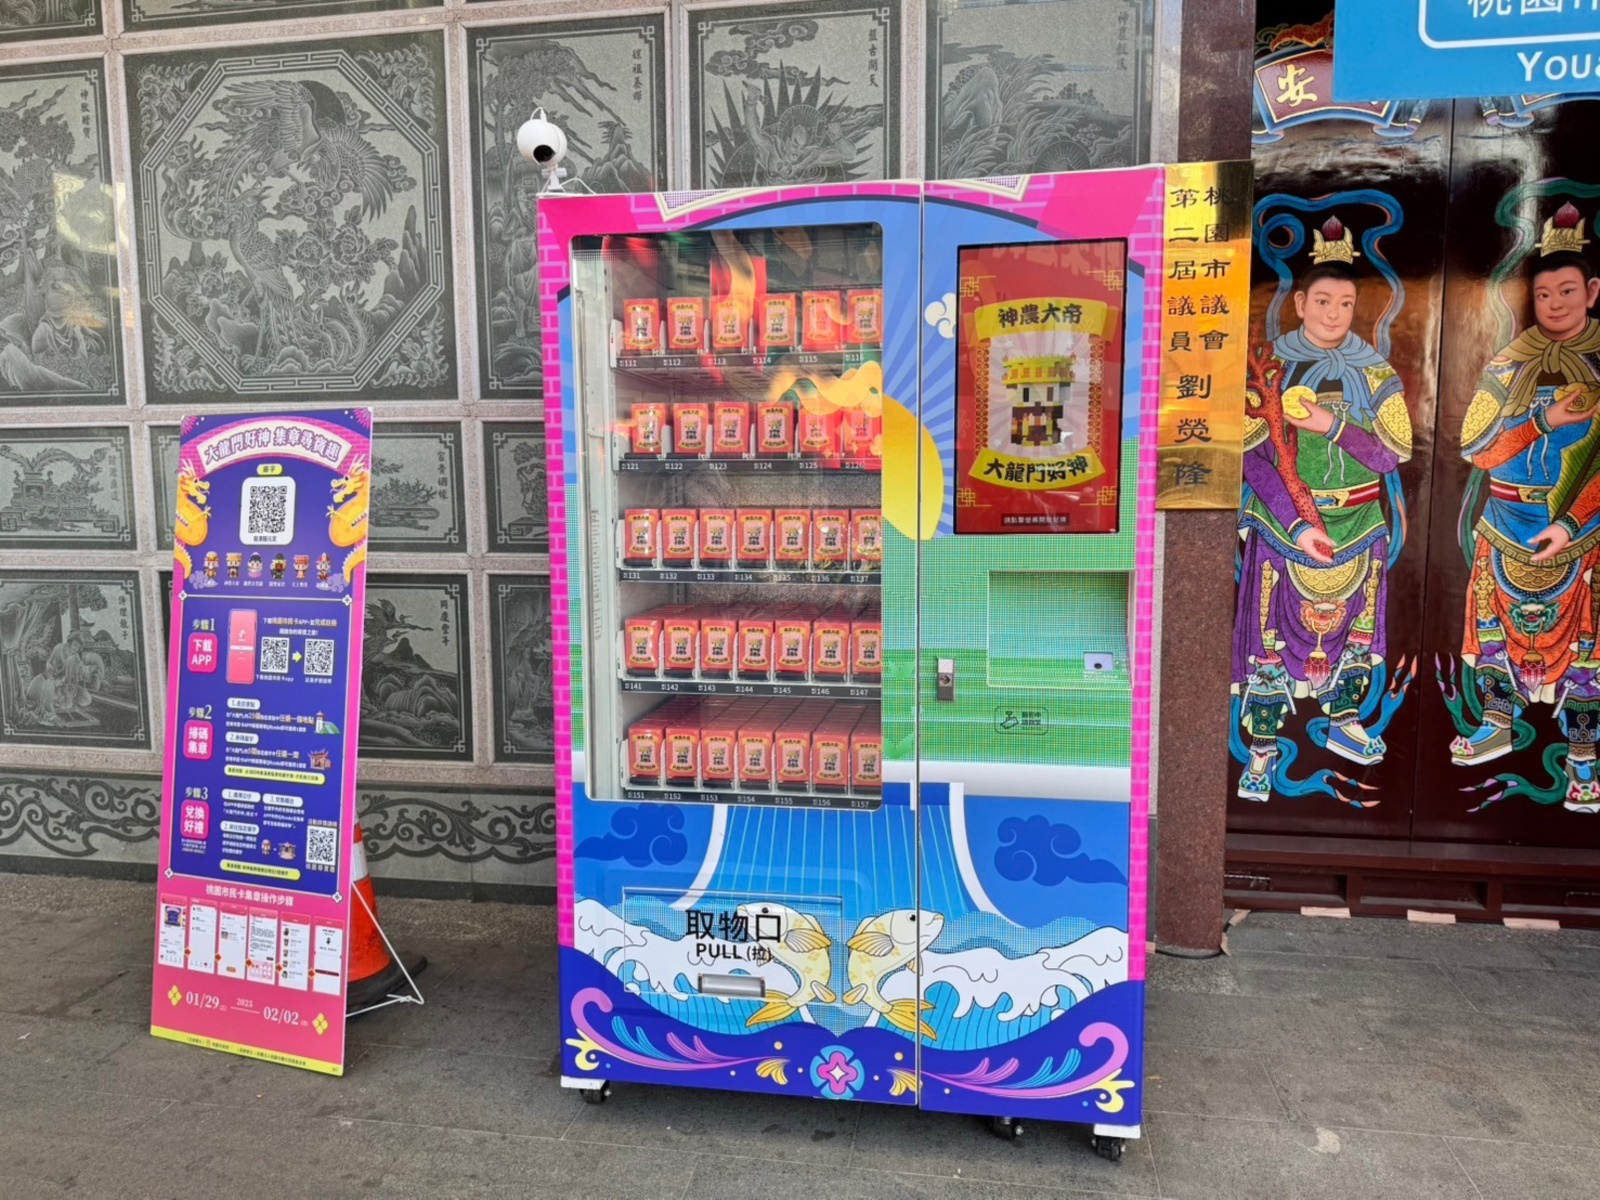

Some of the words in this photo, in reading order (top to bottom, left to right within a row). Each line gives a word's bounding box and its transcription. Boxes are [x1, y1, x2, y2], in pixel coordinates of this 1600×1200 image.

[1167, 187, 1200, 352] 第二屆議員
[1200, 186, 1232, 351] 桃園市議會
[998, 303, 1083, 328] 神農大帝
[1172, 372, 1213, 487] 劉熒隆
[204, 428, 272, 466] 大龍門好神
[273, 427, 343, 462] 集章尋寶趣
[983, 454, 1089, 483] 大龍門好神
[192, 638, 213, 652] 下載
[192, 653, 212, 666] APP
[188, 726, 209, 741] 掃碼
[187, 741, 208, 755] 集章
[184, 806, 205, 820] 兌換
[184, 820, 204, 835] 好禮
[685, 909, 781, 943] 取物口
[186, 991, 220, 1009] 01/29
[236, 998, 254, 1008] 2025
[264, 1006, 299, 1026] 02/02
